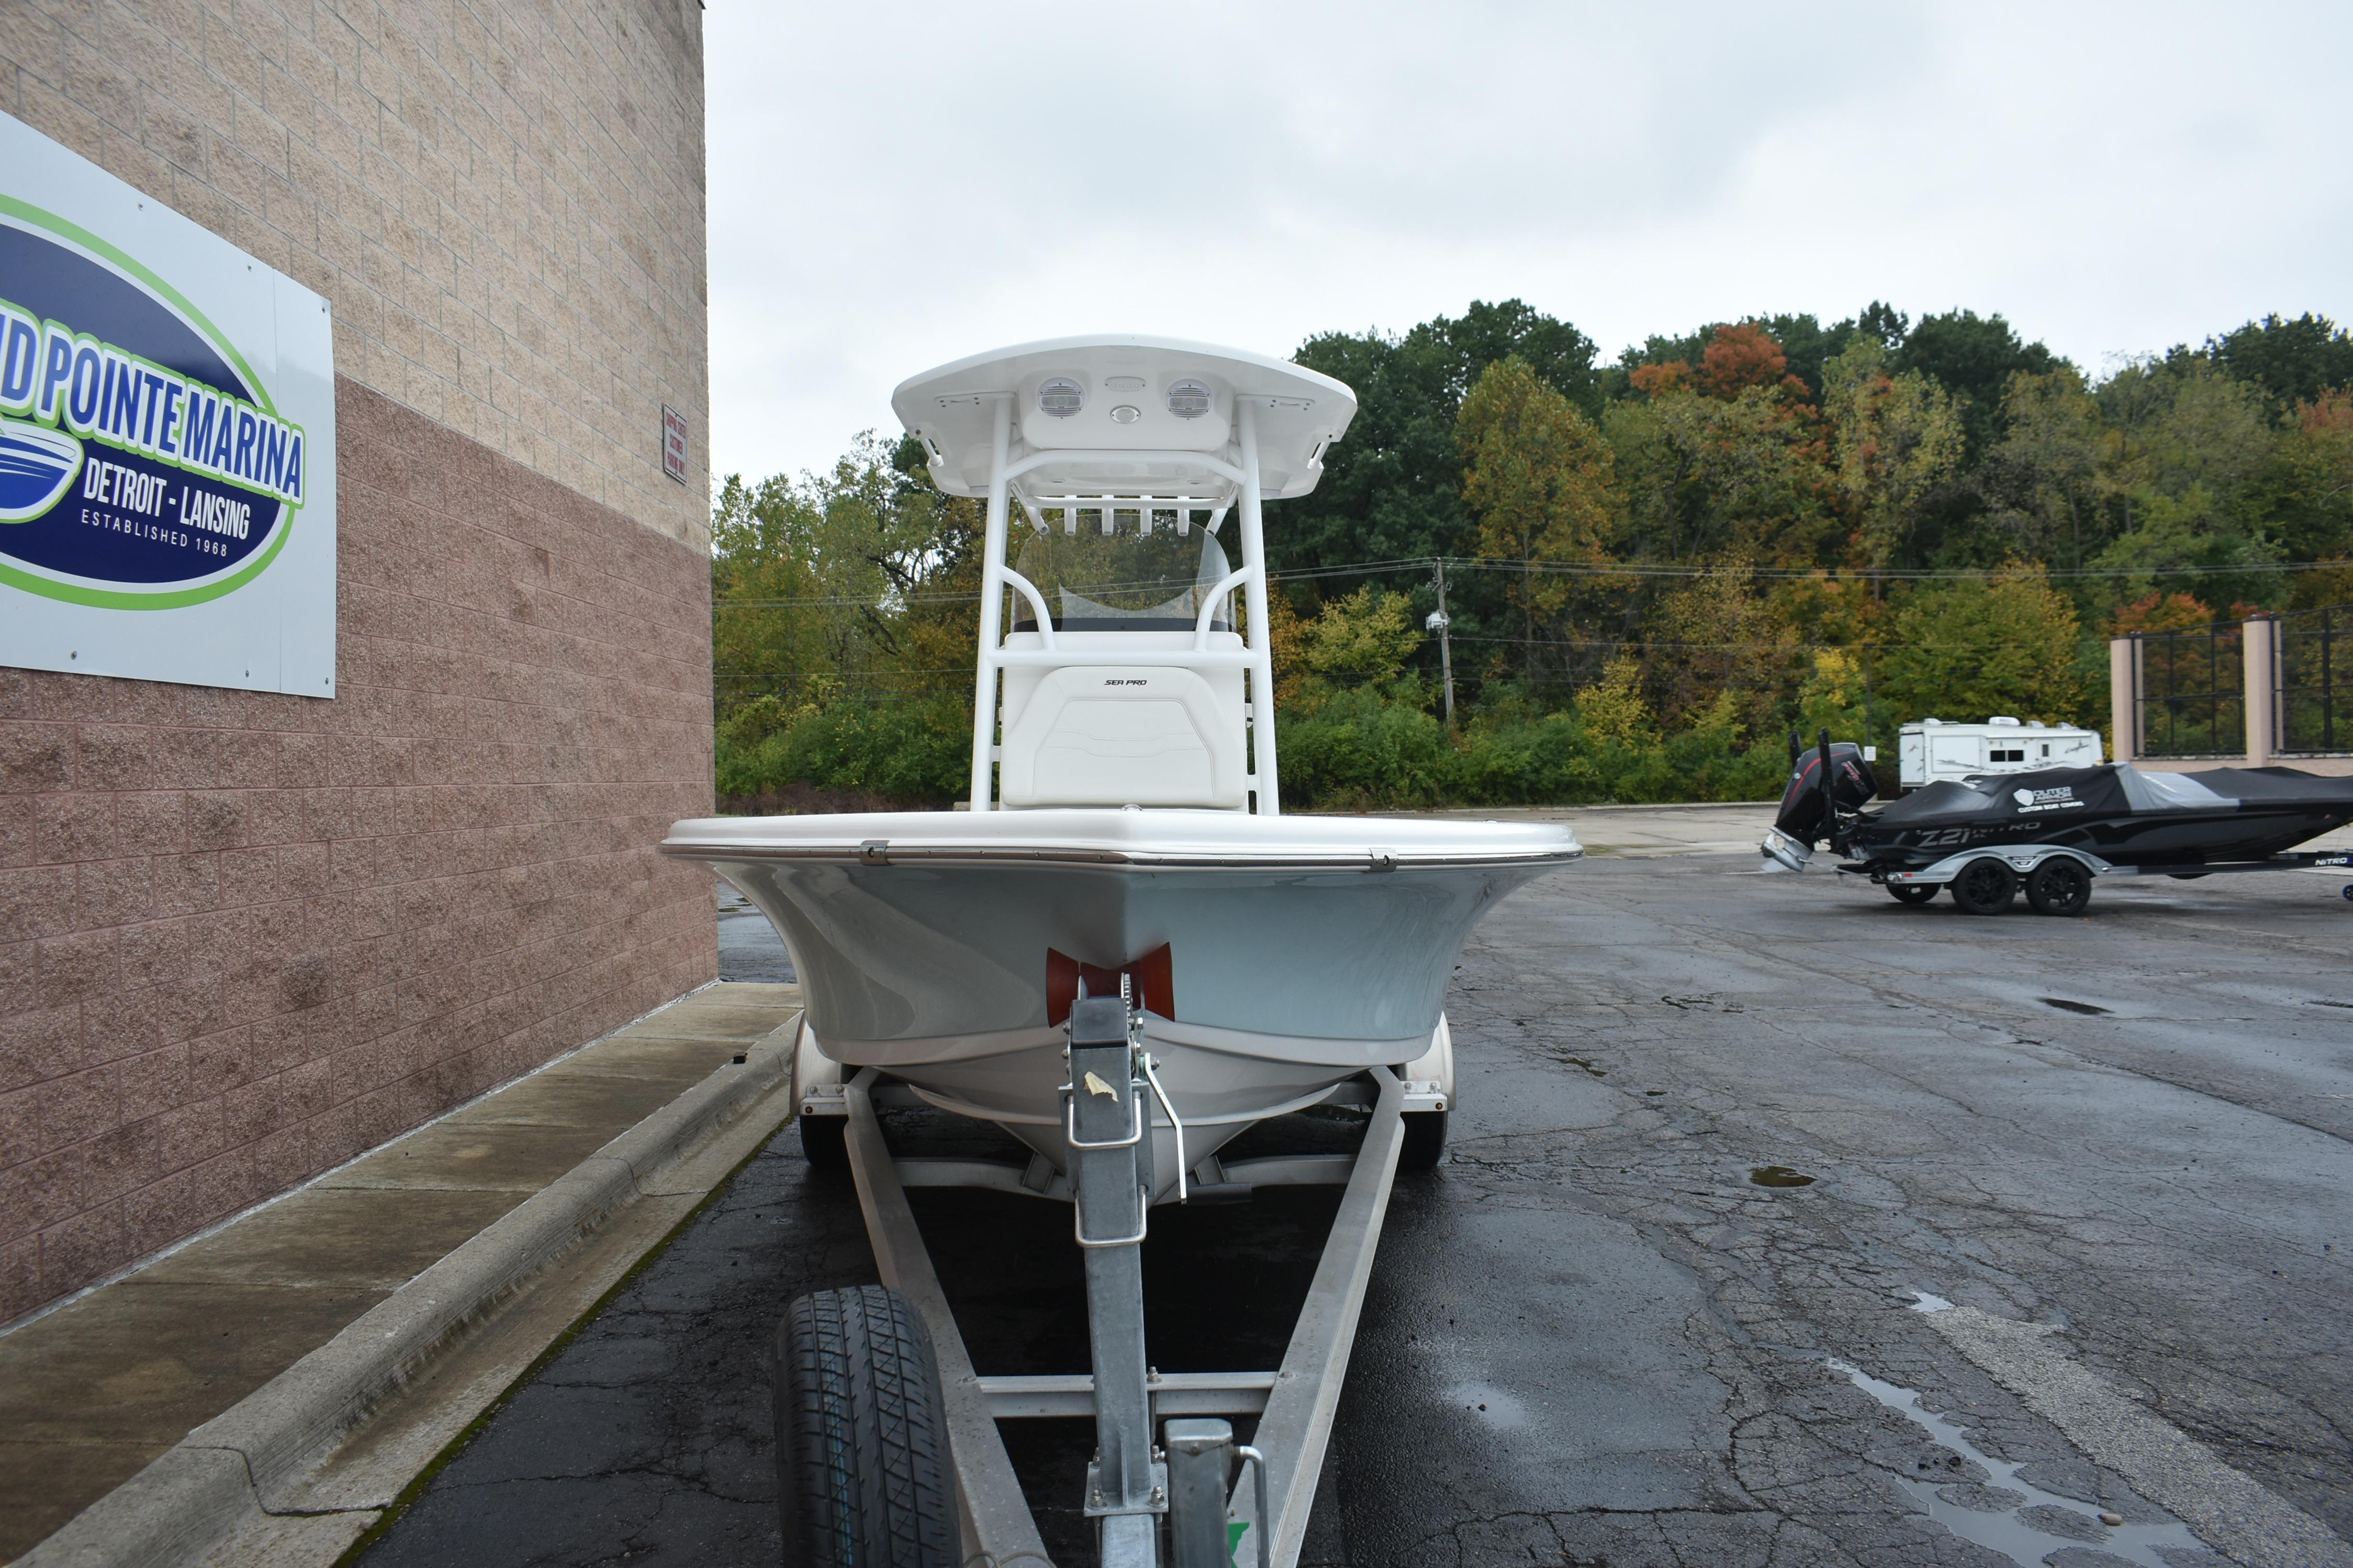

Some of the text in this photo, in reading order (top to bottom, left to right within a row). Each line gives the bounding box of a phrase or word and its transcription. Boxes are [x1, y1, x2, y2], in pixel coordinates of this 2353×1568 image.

[0, 313, 301, 499] D POINTE MARINA
[84, 457, 167, 517] DETROIT
[180, 486, 250, 540] LANSING
[82, 509, 227, 557] ESTABLISHED 1968
[2033, 786, 2071, 796] OUTER
[1918, 828, 1970, 848] Z21
[2315, 857, 2348, 866] NITRO
